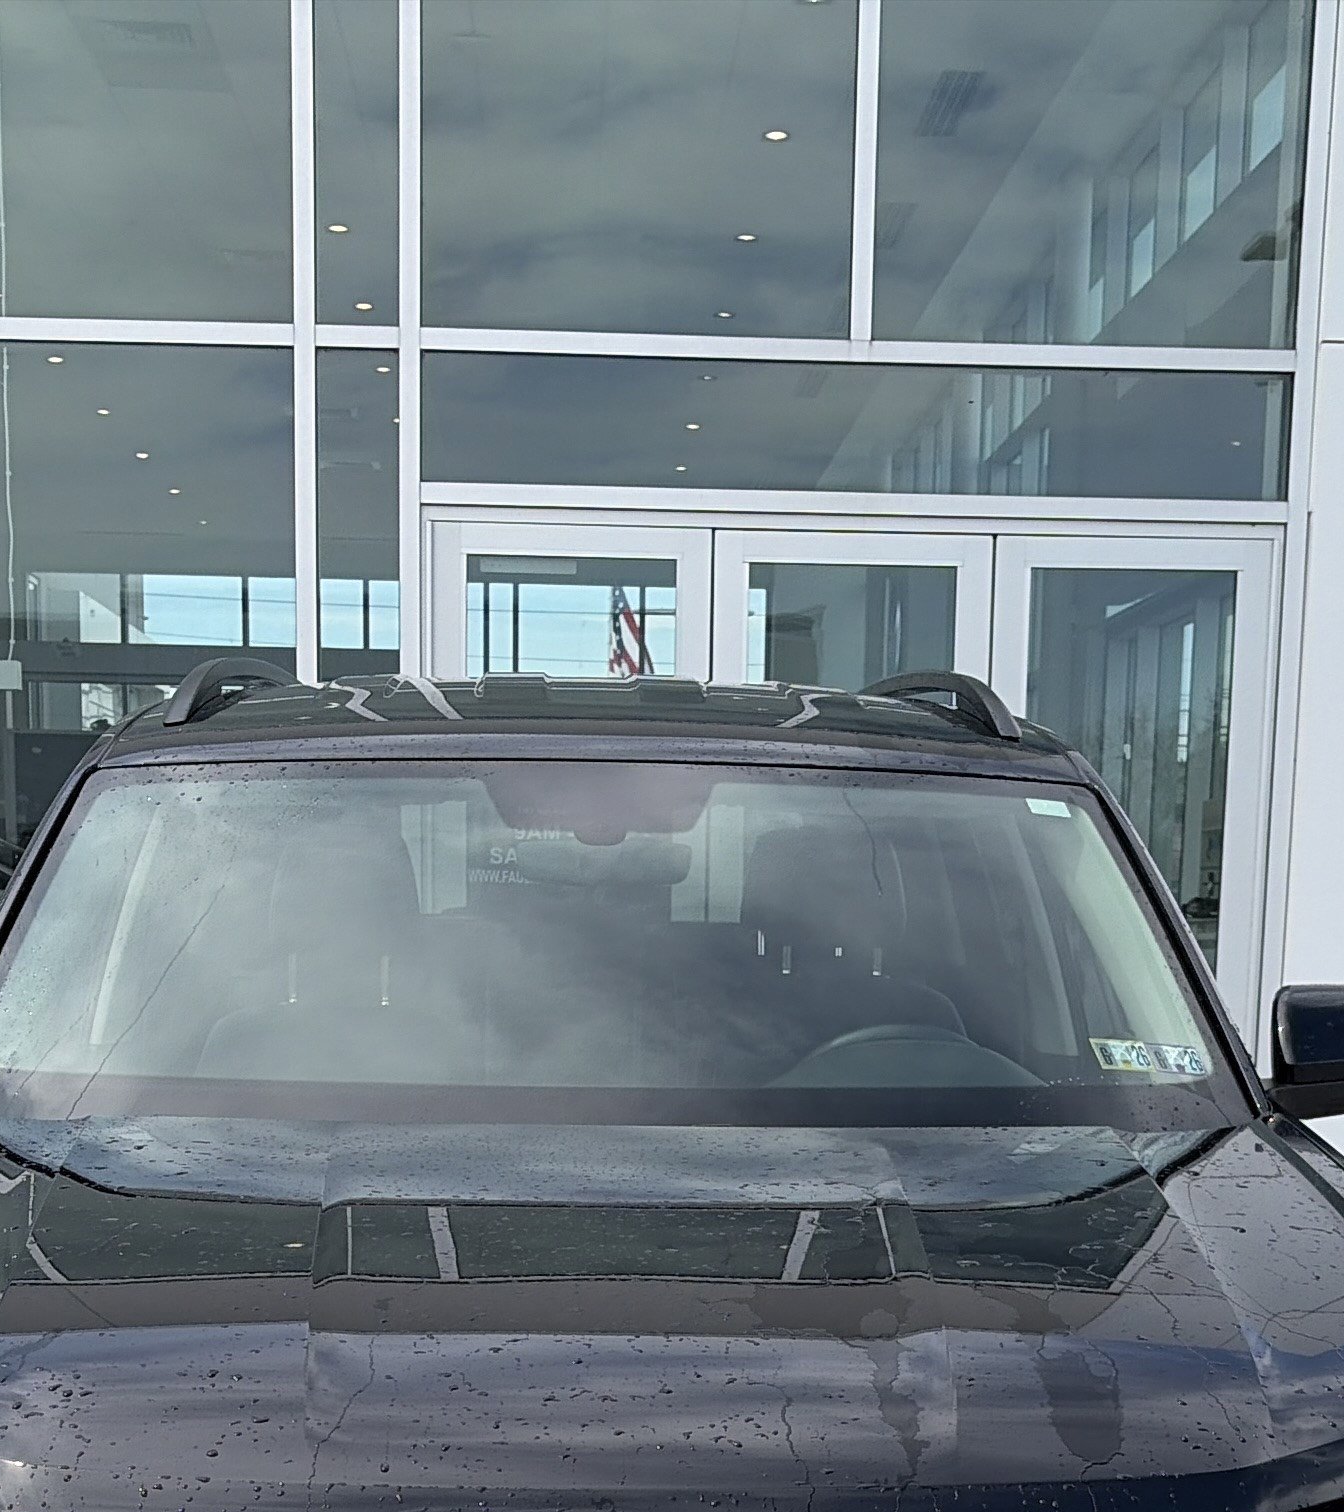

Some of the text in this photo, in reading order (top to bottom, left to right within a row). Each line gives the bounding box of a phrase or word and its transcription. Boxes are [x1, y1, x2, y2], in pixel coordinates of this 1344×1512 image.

[489, 847, 518, 864] SA
[468, 869, 534, 884] WWW.FAU
[1131, 1044, 1151, 1067] 26
